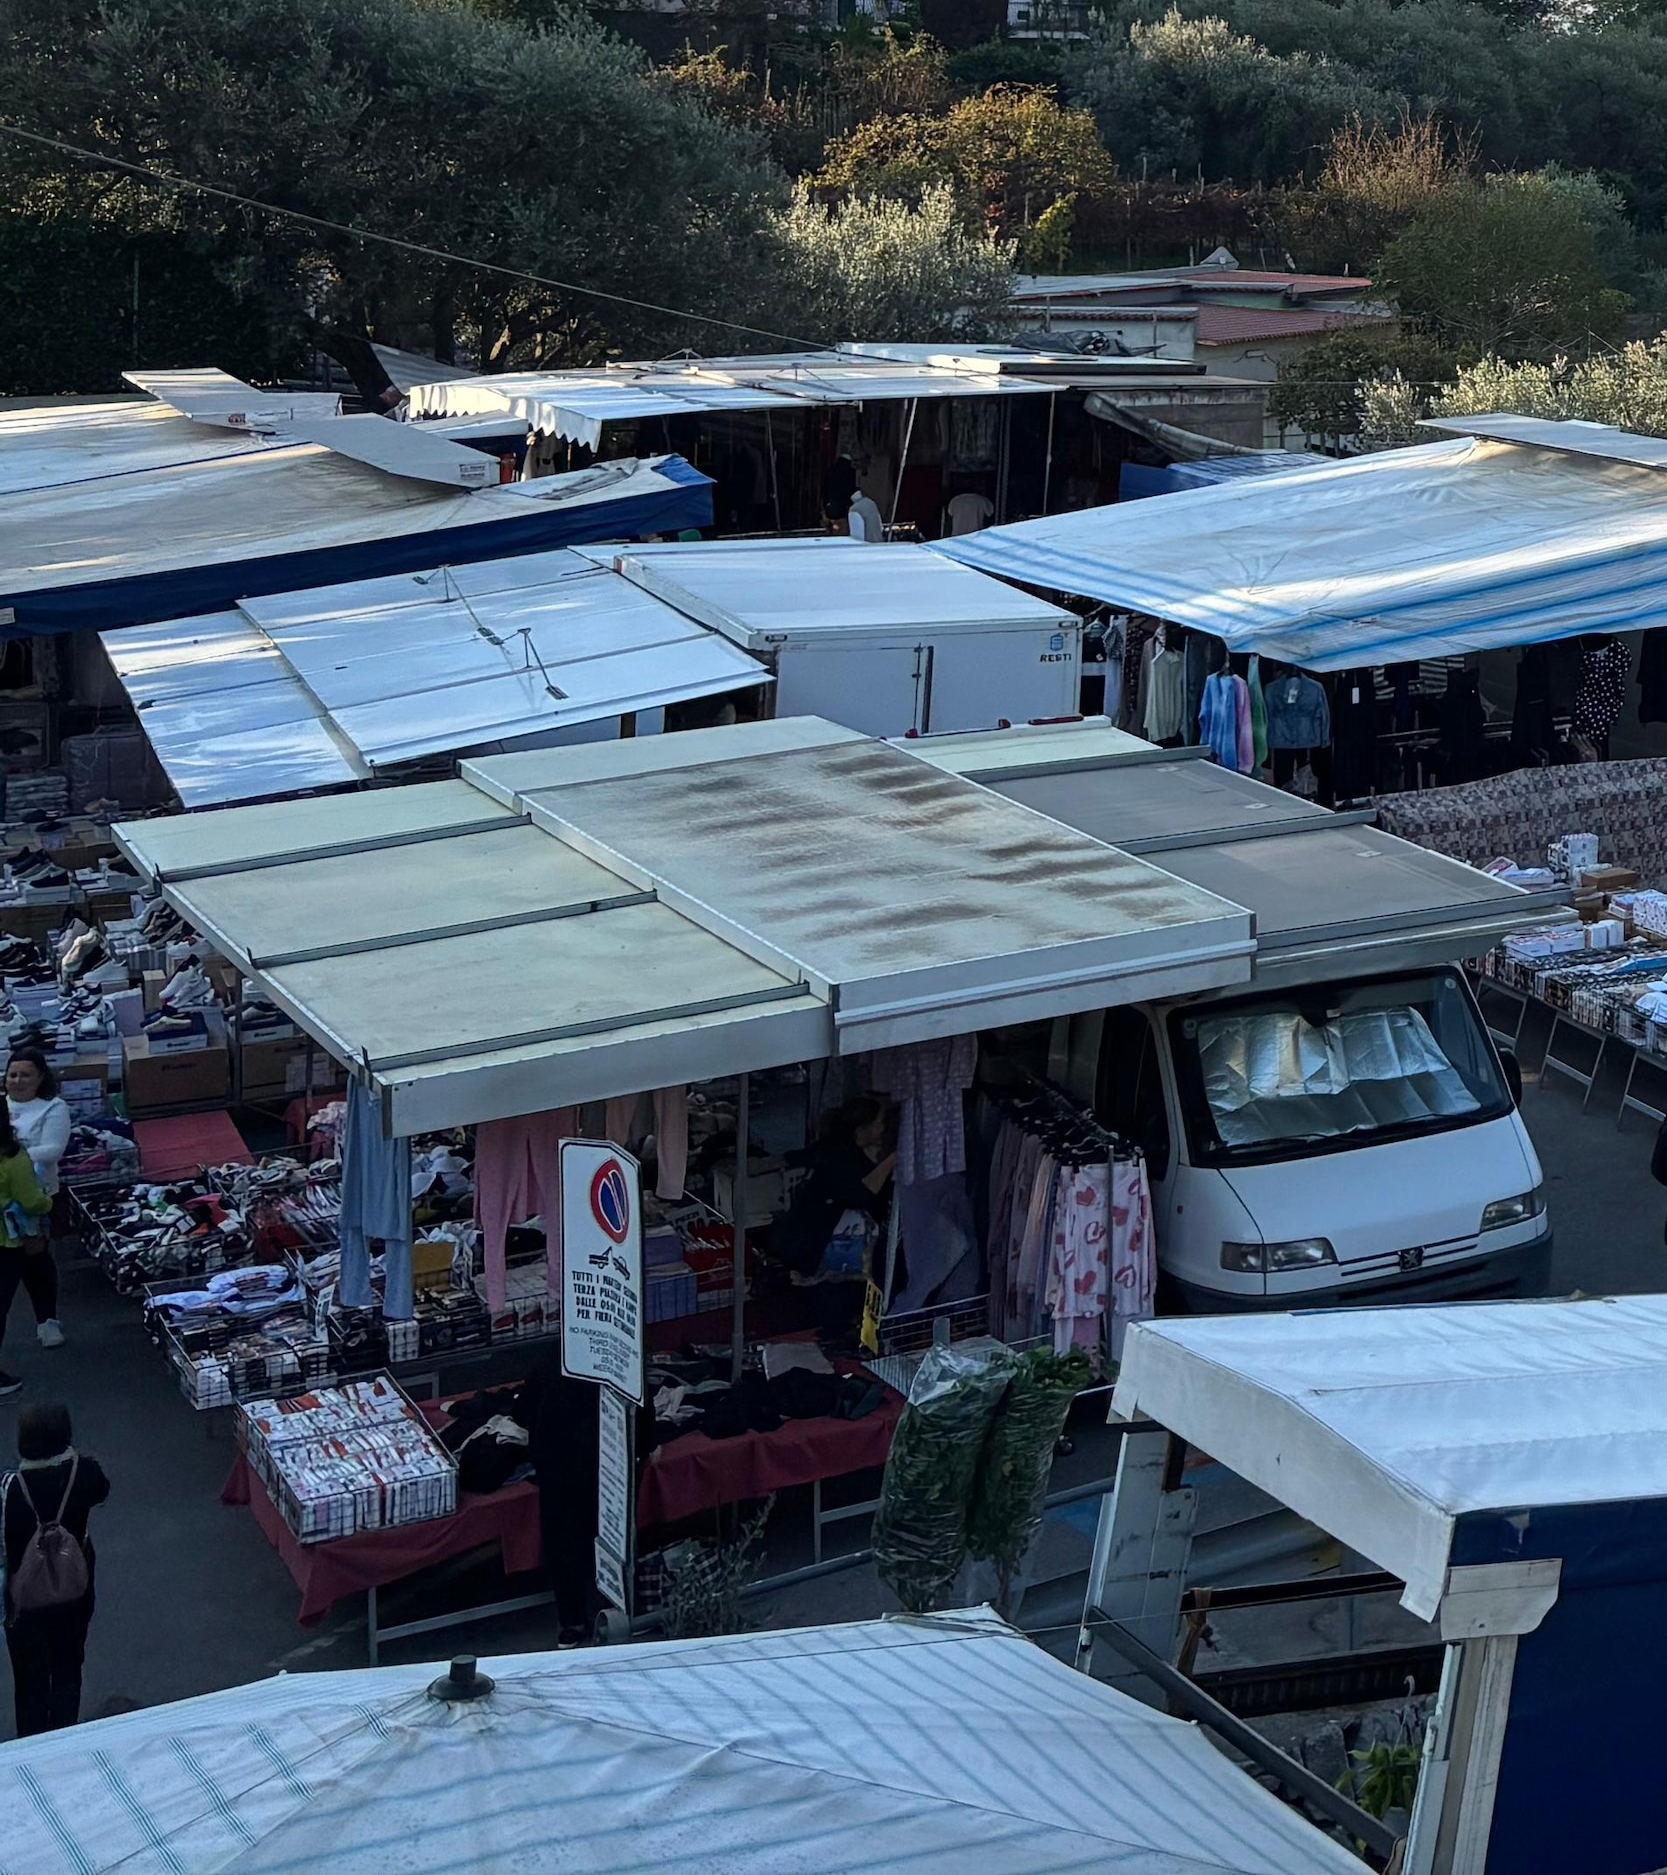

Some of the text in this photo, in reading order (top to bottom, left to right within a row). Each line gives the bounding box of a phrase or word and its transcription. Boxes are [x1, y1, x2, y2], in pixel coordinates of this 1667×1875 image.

[571, 1270, 593, 1282] TUTTI
[573, 1283, 595, 1295] TERZA
[576, 1308, 591, 1320] PER
